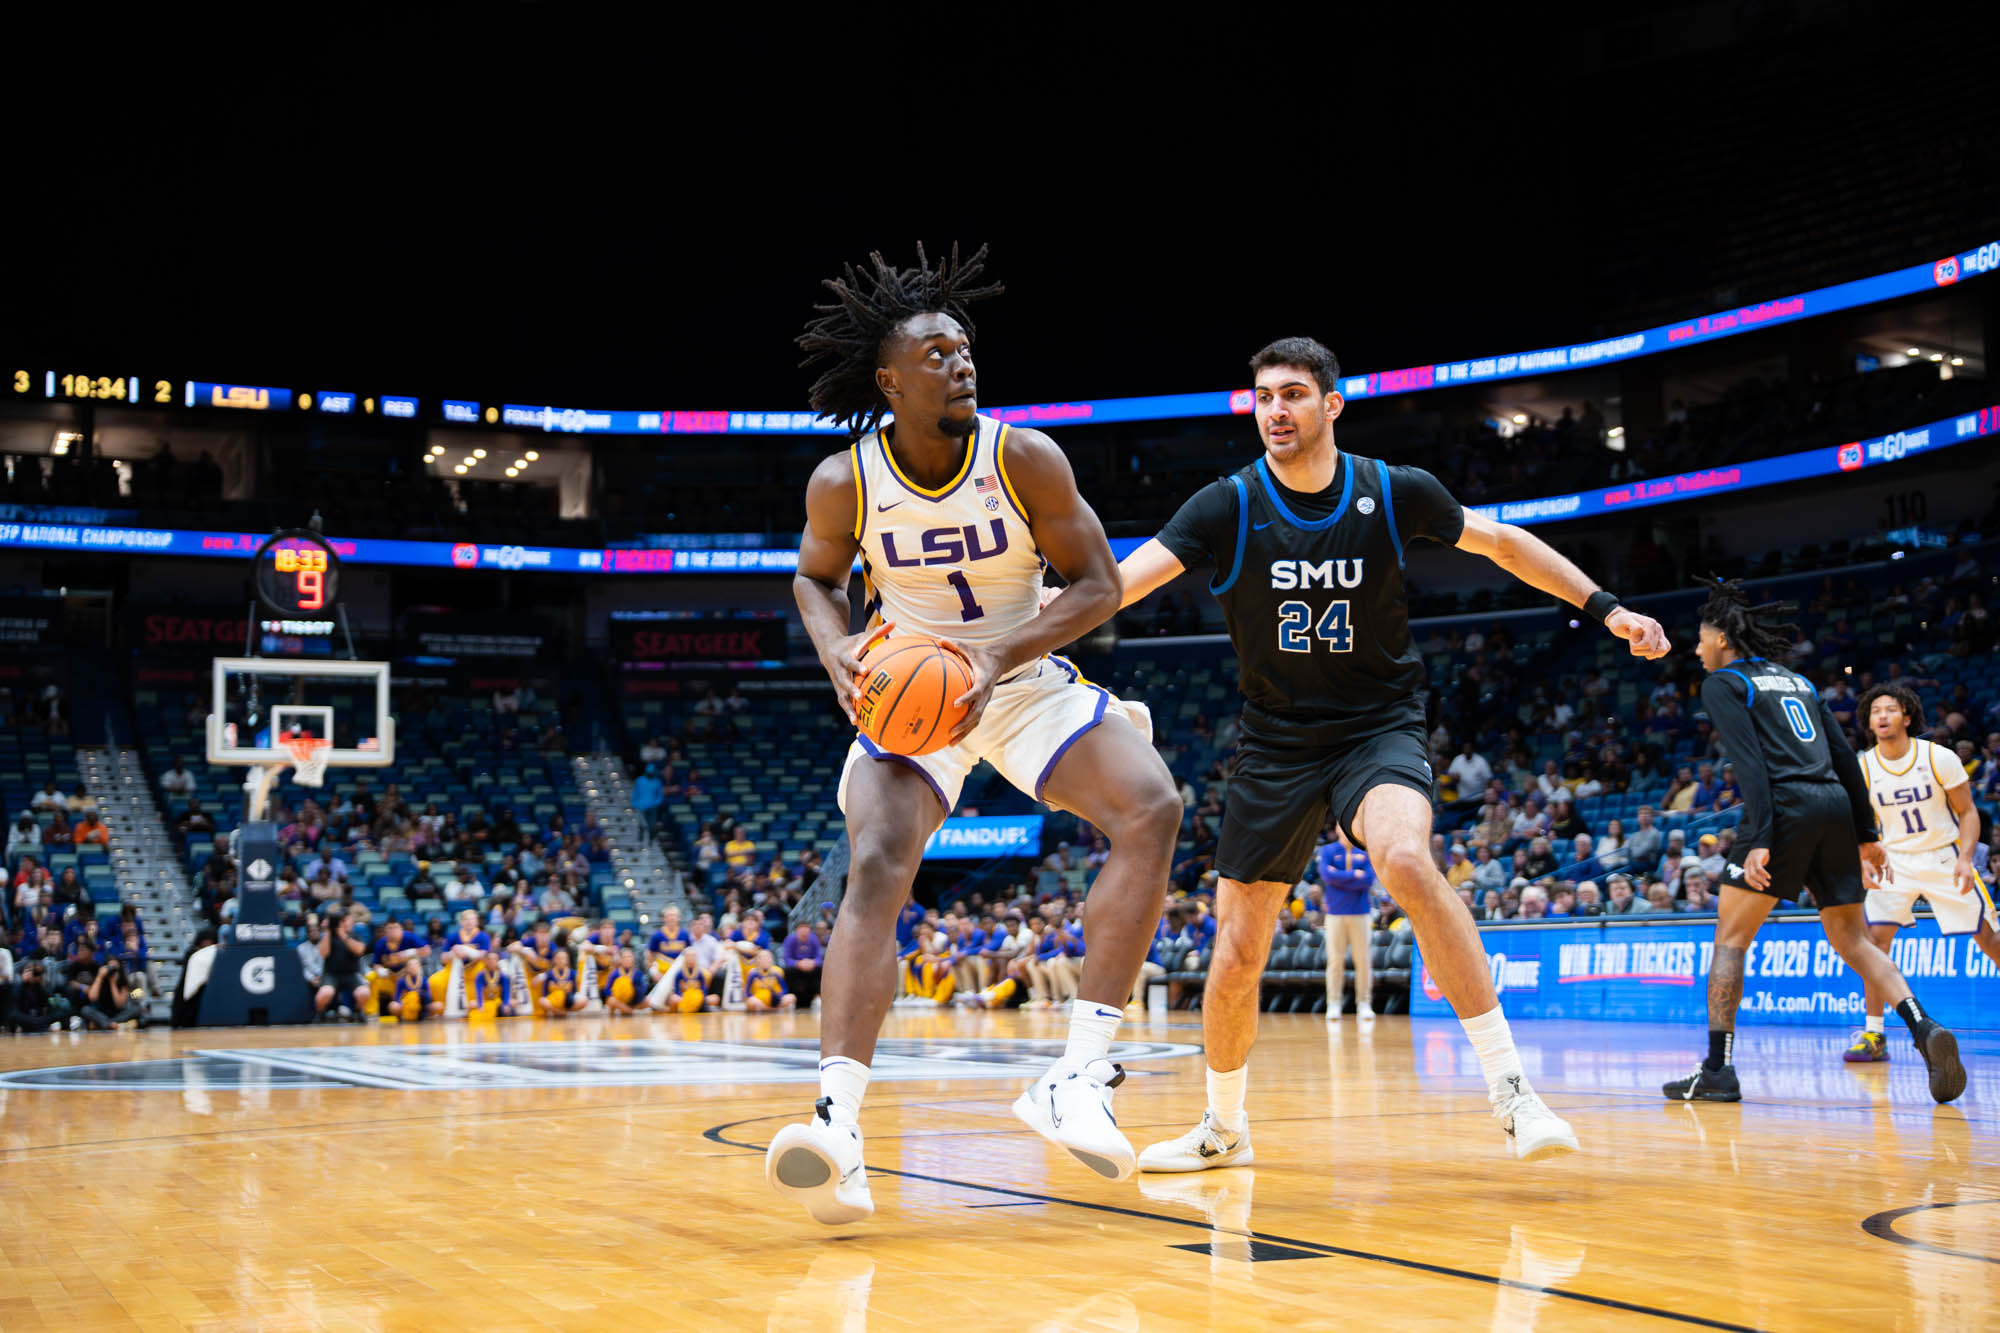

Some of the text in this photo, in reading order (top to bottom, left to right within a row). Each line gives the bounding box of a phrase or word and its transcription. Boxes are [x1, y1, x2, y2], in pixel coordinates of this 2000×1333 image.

[14, 370, 30, 393] 3
[62, 374, 126, 400] 18:34
[154, 380, 172, 403] 2
[212, 386, 269, 410] LSU
[1978, 408, 1989, 435] 2
[1883, 432, 1906, 461] GO
[21, 526, 79, 544] NATIONAL
[81, 528, 174, 547] CHAMPIONSHIP
[881, 518, 1009, 567] LSU
[1270, 558, 1364, 590] SMU
[297, 570, 325, 610] 9
[946, 570, 985, 622] 1
[280, 620, 336, 635] TISSOT
[1278, 599, 1354, 653] 24
[633, 631, 762, 657] SEATGEEK
[858, 668, 892, 729] ELITE
[1781, 696, 1817, 742] 0
[1877, 783, 1933, 807] LSU
[1901, 807, 1928, 834] 11
[1559, 943, 1590, 976] WIN
[1593, 943, 1628, 976] TWO
[1631, 941, 1695, 976] TICKETS
[1699, 941, 1714, 977] T
[1760, 939, 1810, 978] 2026
[1889, 937, 1958, 978] IONAL
[240, 956, 276, 994] G
